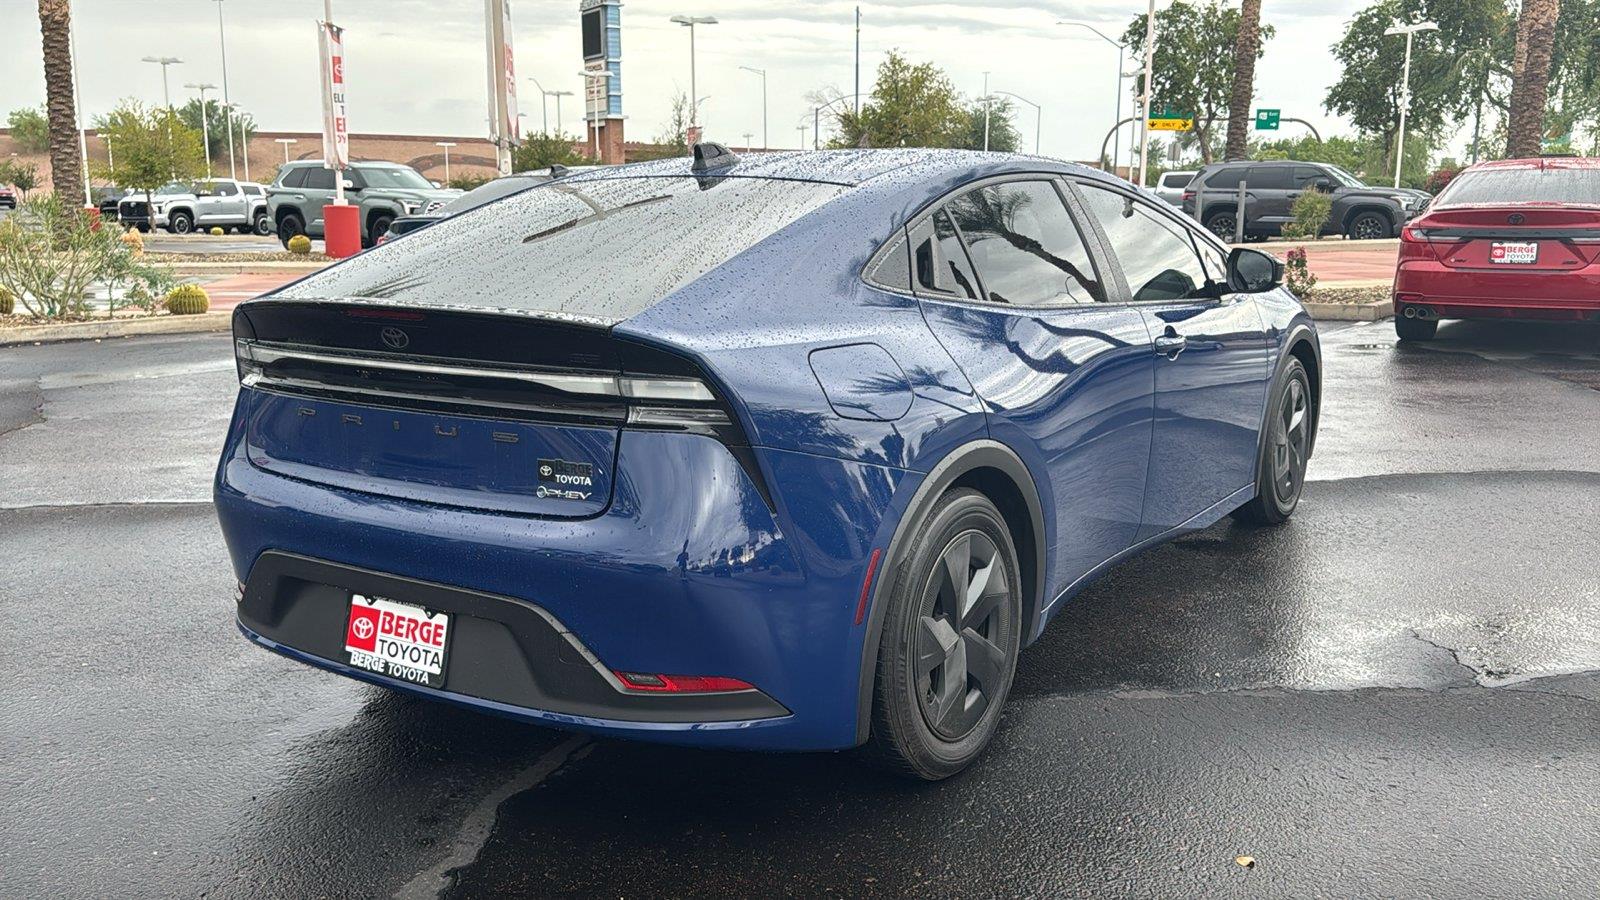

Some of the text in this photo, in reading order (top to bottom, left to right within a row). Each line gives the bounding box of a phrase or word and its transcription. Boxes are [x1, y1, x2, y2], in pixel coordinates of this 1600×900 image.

[1506, 246, 1535, 254] BERGE
[298, 406, 520, 444] PRIUS
[555, 474, 592, 486] TOYOTA
[381, 611, 445, 648] BERGE
[350, 651, 430, 685] BERGE TOYOTA
[379, 639, 442, 669] TOYOTA
